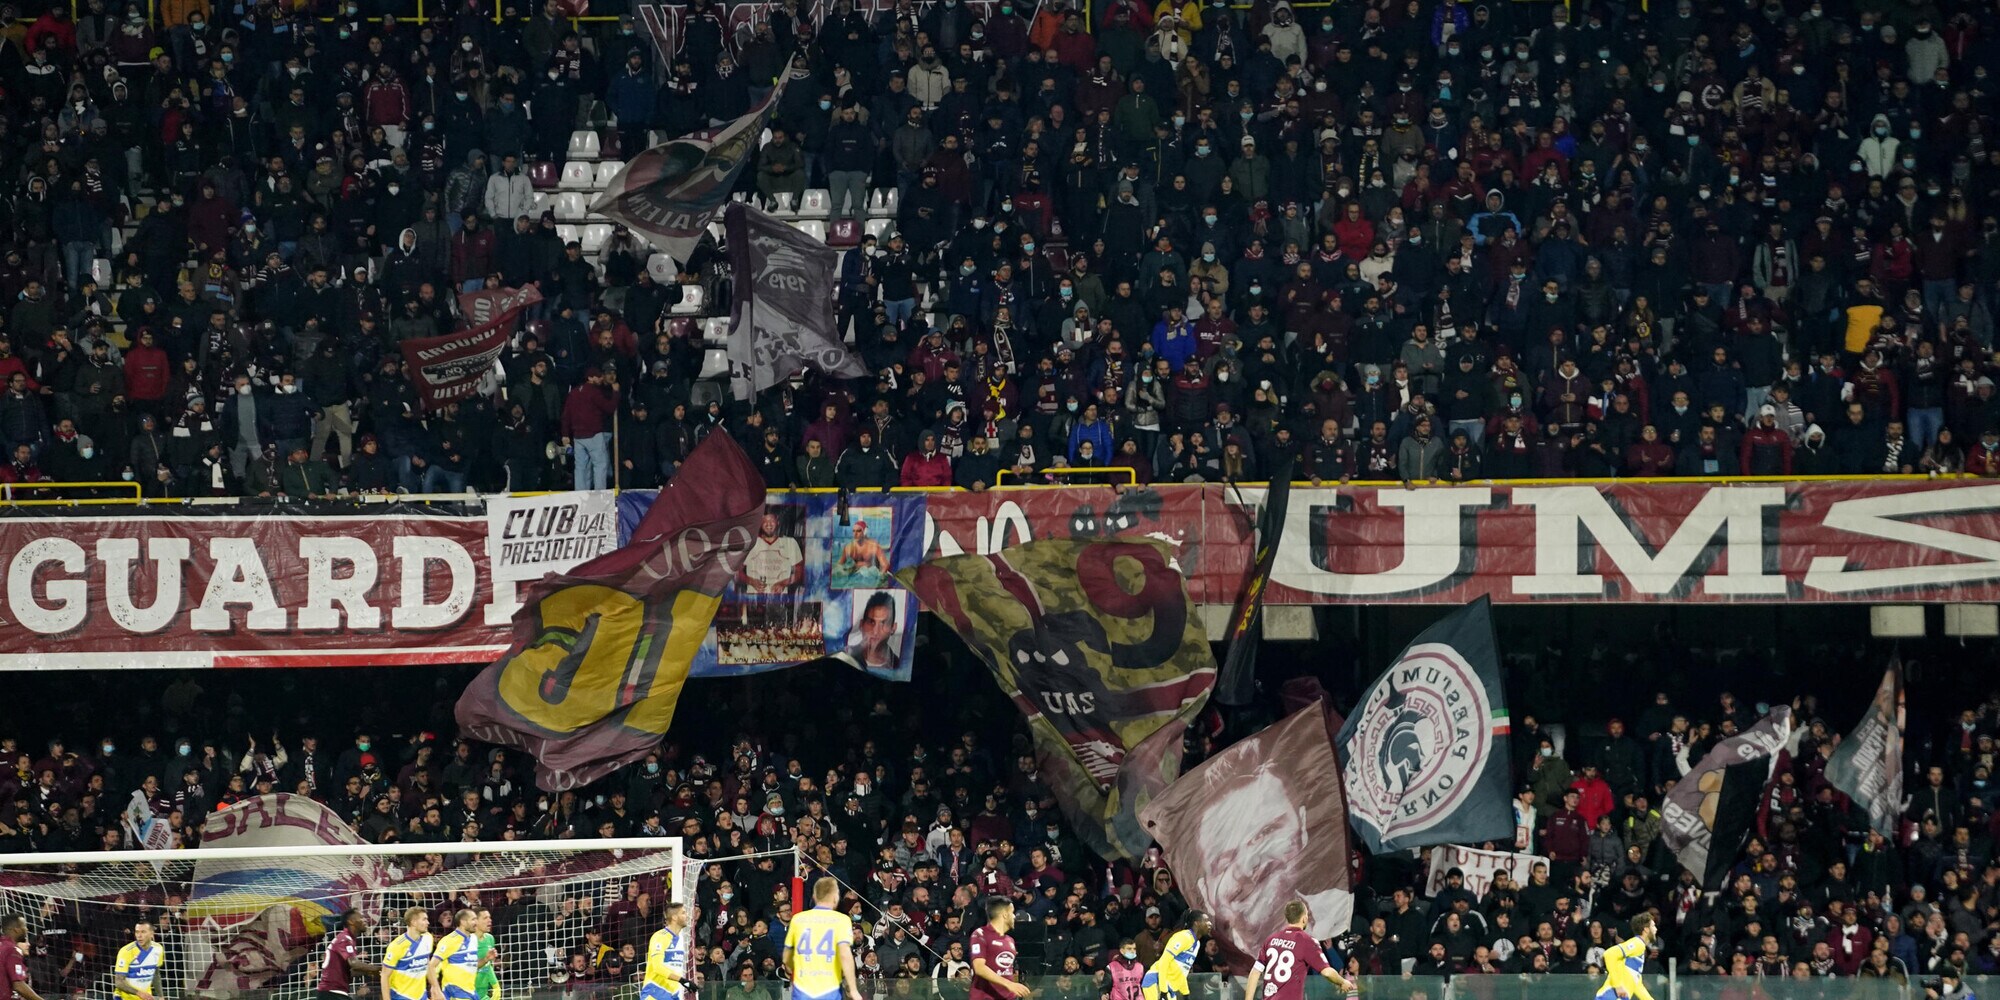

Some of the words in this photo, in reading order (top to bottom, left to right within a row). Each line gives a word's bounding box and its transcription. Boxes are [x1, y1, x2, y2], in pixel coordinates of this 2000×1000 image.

[503, 504, 578, 540] CLUB
[578, 512, 606, 535] DAL
[500, 535, 607, 566] PRESIDENTE
[1440, 844, 1517, 871] TUTTO
[797, 927, 836, 963] 44
[1264, 947, 1295, 983] 28
